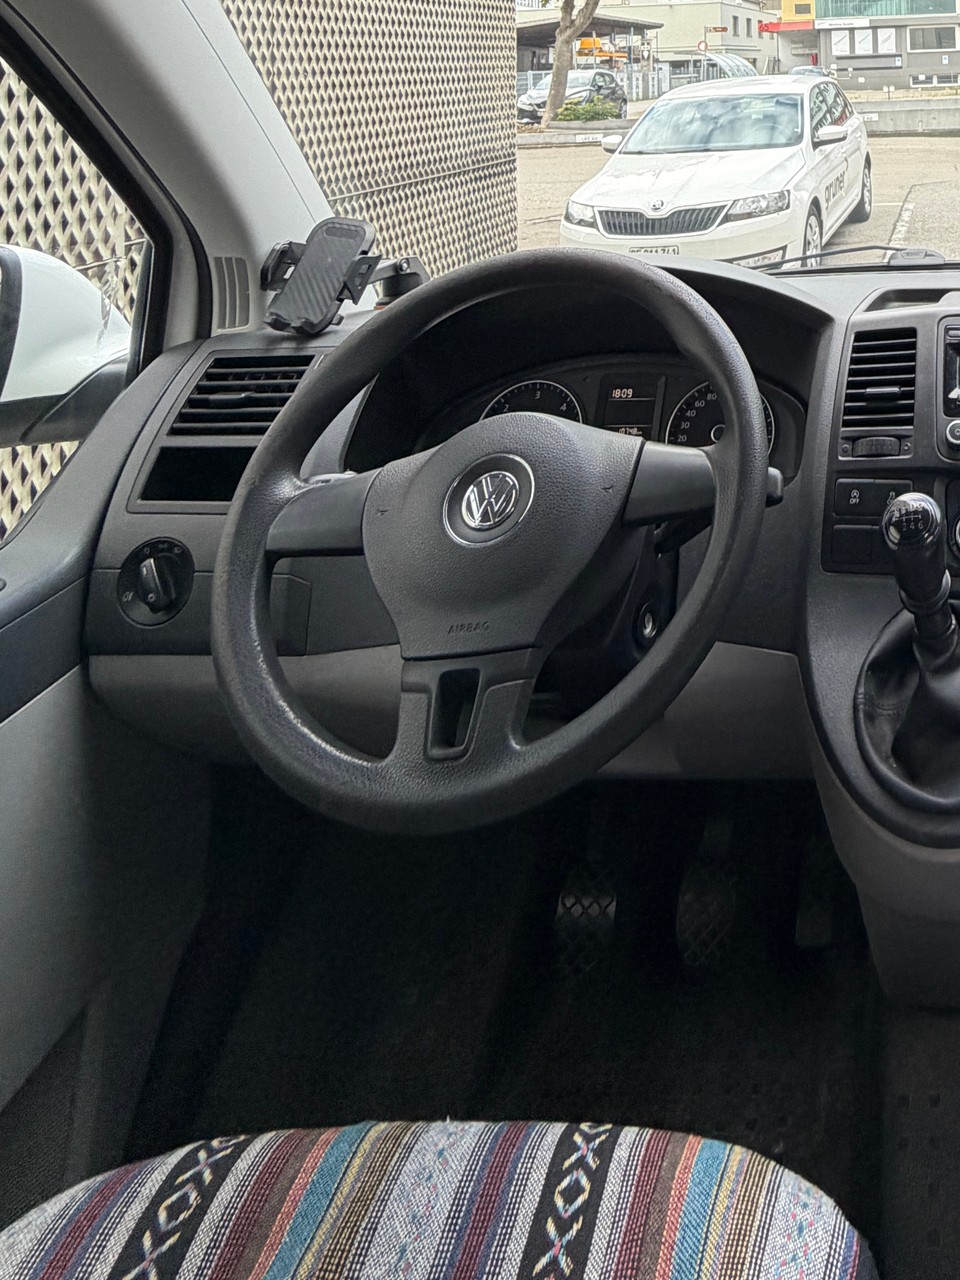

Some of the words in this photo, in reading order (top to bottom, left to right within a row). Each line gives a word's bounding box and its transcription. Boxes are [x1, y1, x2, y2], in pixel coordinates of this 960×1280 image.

[824, 170, 846, 210] gruner
[534, 391, 541, 399] 3
[706, 392, 718, 401] 80
[503, 404, 510, 412] 2
[560, 403, 567, 411] 4
[694, 400, 705, 408] 60
[685, 409, 696, 418] 40
[680, 421, 690, 429] 30
[677, 434, 687, 442] 20
[849, 497, 860, 505] OFF
[448, 622, 489, 635] AIRBAG
